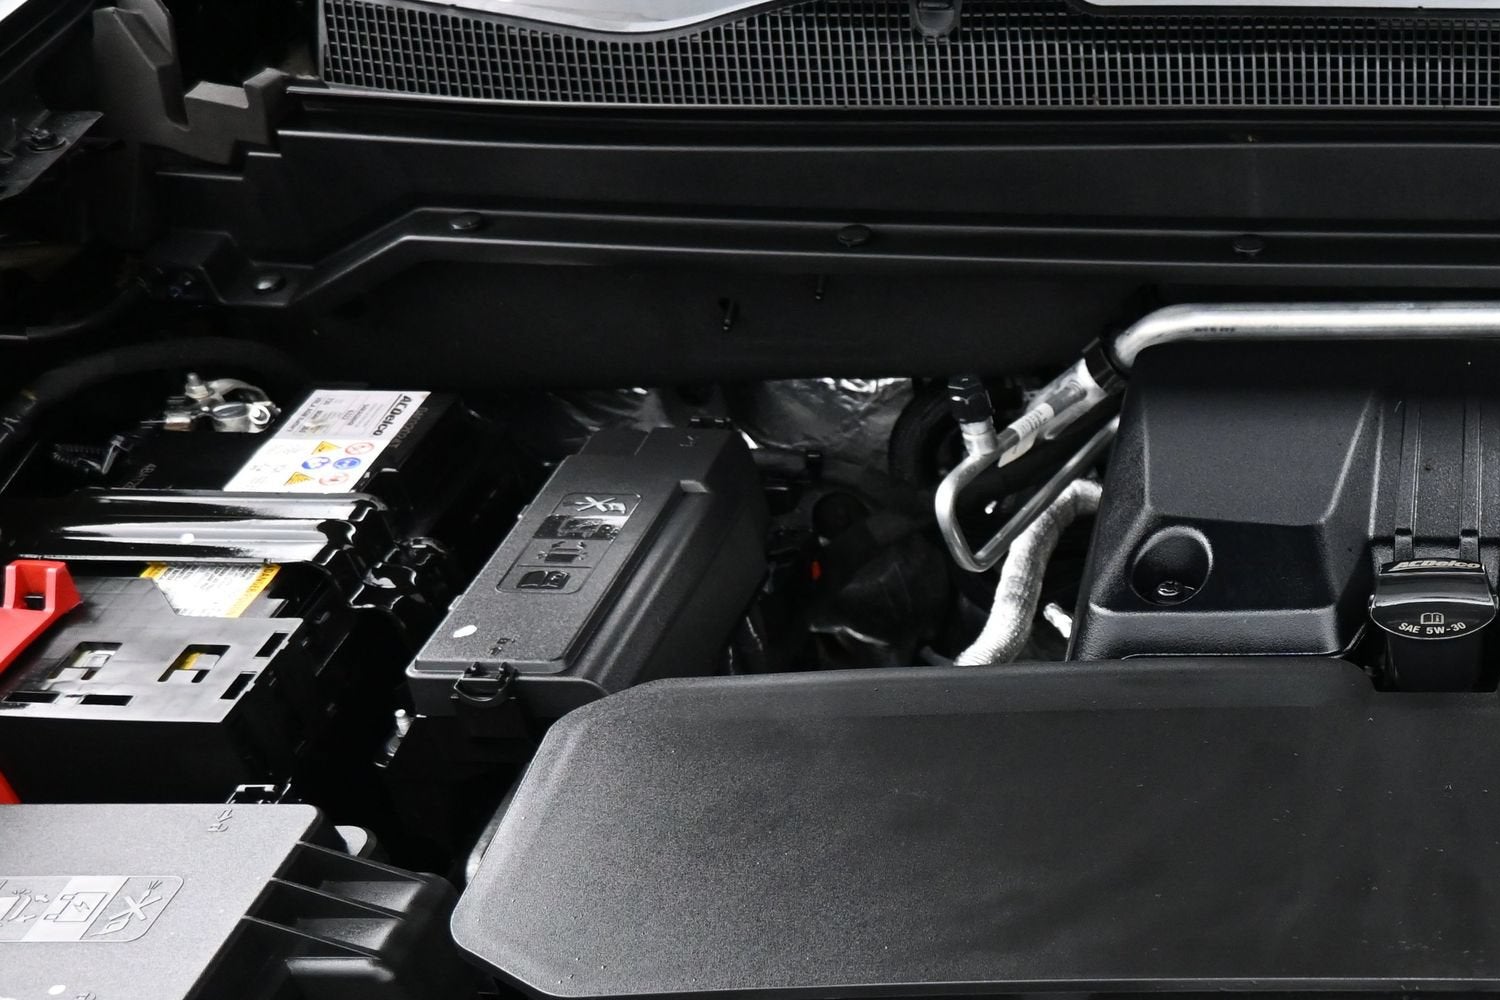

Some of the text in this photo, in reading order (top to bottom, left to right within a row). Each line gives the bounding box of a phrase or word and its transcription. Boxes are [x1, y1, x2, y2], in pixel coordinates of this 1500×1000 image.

[373, 394, 413, 437] ACDelco
[1388, 560, 1481, 572] ACDelco
[1399, 622, 1466, 634] SAE 5W-30
